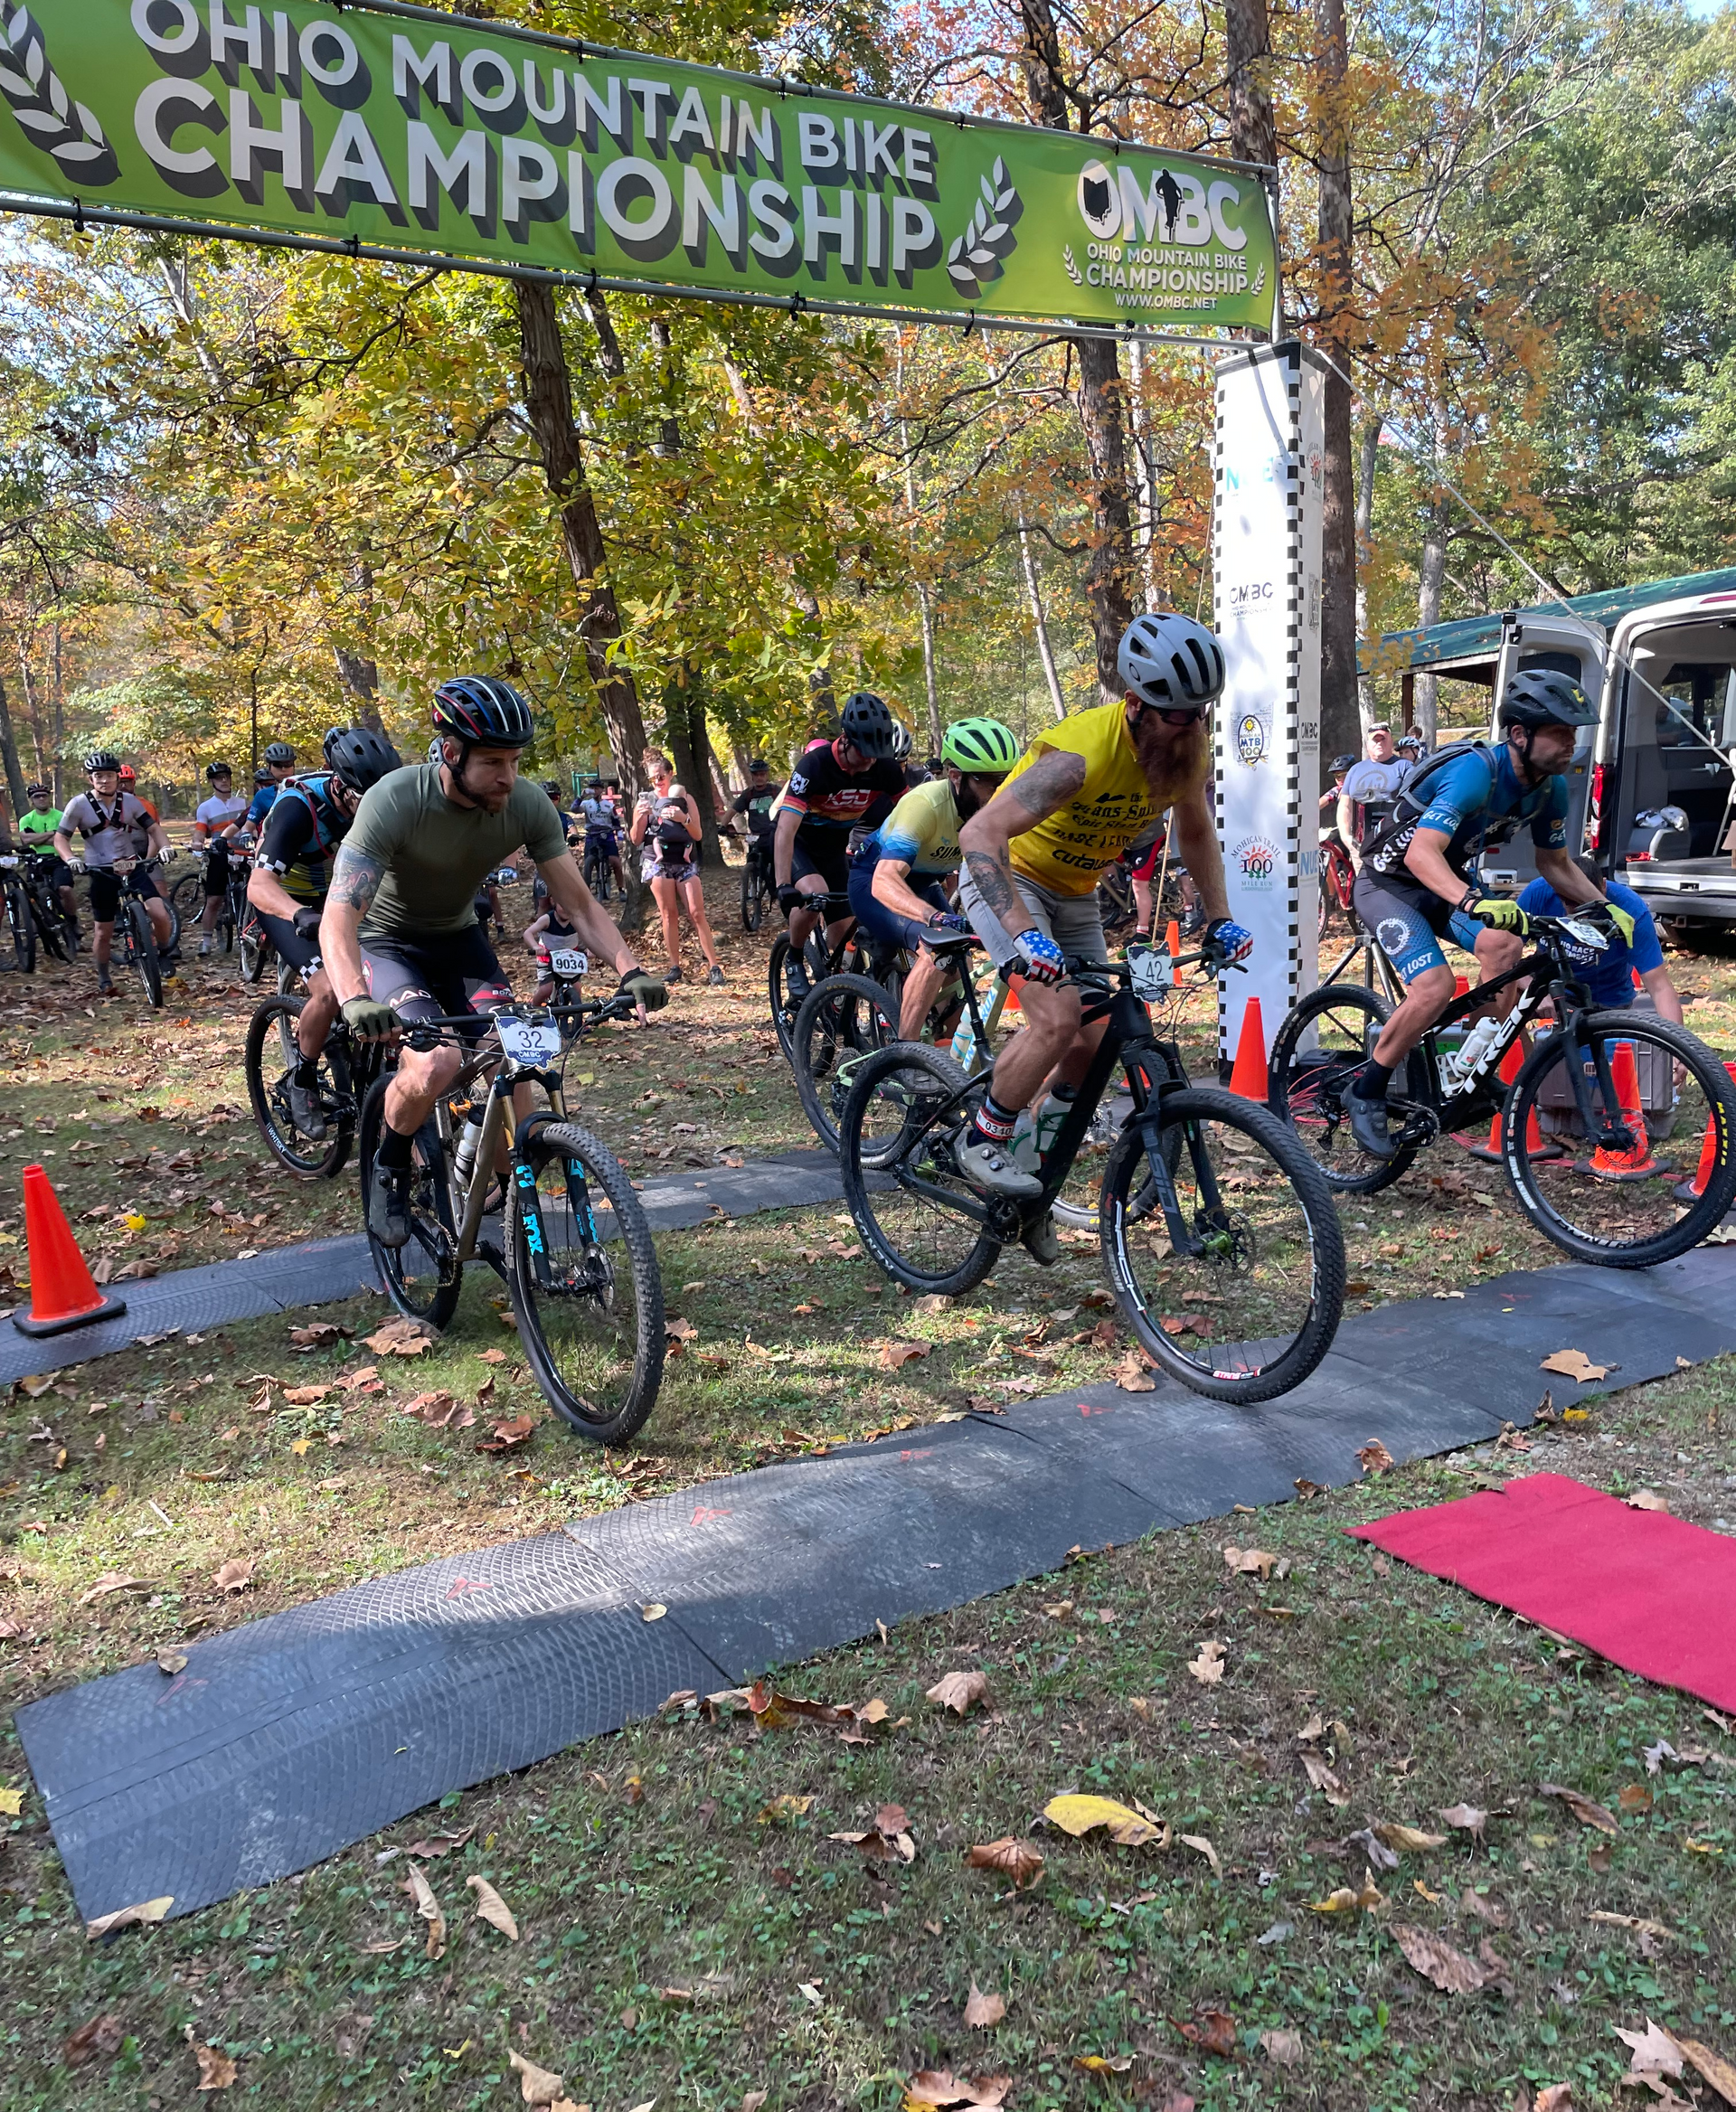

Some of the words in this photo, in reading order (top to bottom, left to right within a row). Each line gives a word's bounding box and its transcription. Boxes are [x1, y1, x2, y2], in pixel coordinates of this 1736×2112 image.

[130, 0, 359, 87] OHIO
[392, 33, 775, 164] MOUNTAIN
[799, 111, 933, 184] BIKE
[134, 77, 936, 272] CHAMPIONSHIP
[1077, 158, 1248, 251] OMBC
[1087, 242, 1122, 263] OHIO
[1127, 247, 1211, 268] MOUNTAIN
[1214, 253, 1248, 271] BIKE
[1086, 262, 1249, 294] CHAMPIONSHIP
[1114, 293, 1217, 310] WWW.OMBC.NET
[1241, 737, 1261, 748] MTB
[1241, 747, 1260, 757] 100
[1422, 810, 1446, 822] GET
[1231, 835, 1262, 859] MOHICAN
[1263, 837, 1281, 859] TRAIL
[1241, 858, 1273, 874] 100
[555, 958, 585, 970] 9034
[1146, 960, 1165, 983] 42
[1407, 952, 1433, 975] LOST
[518, 1030, 546, 1049] 32
[1464, 986, 1535, 1095] TREK
[523, 1212, 543, 1256] FOX
[854, 1211, 894, 1271] KENDA
